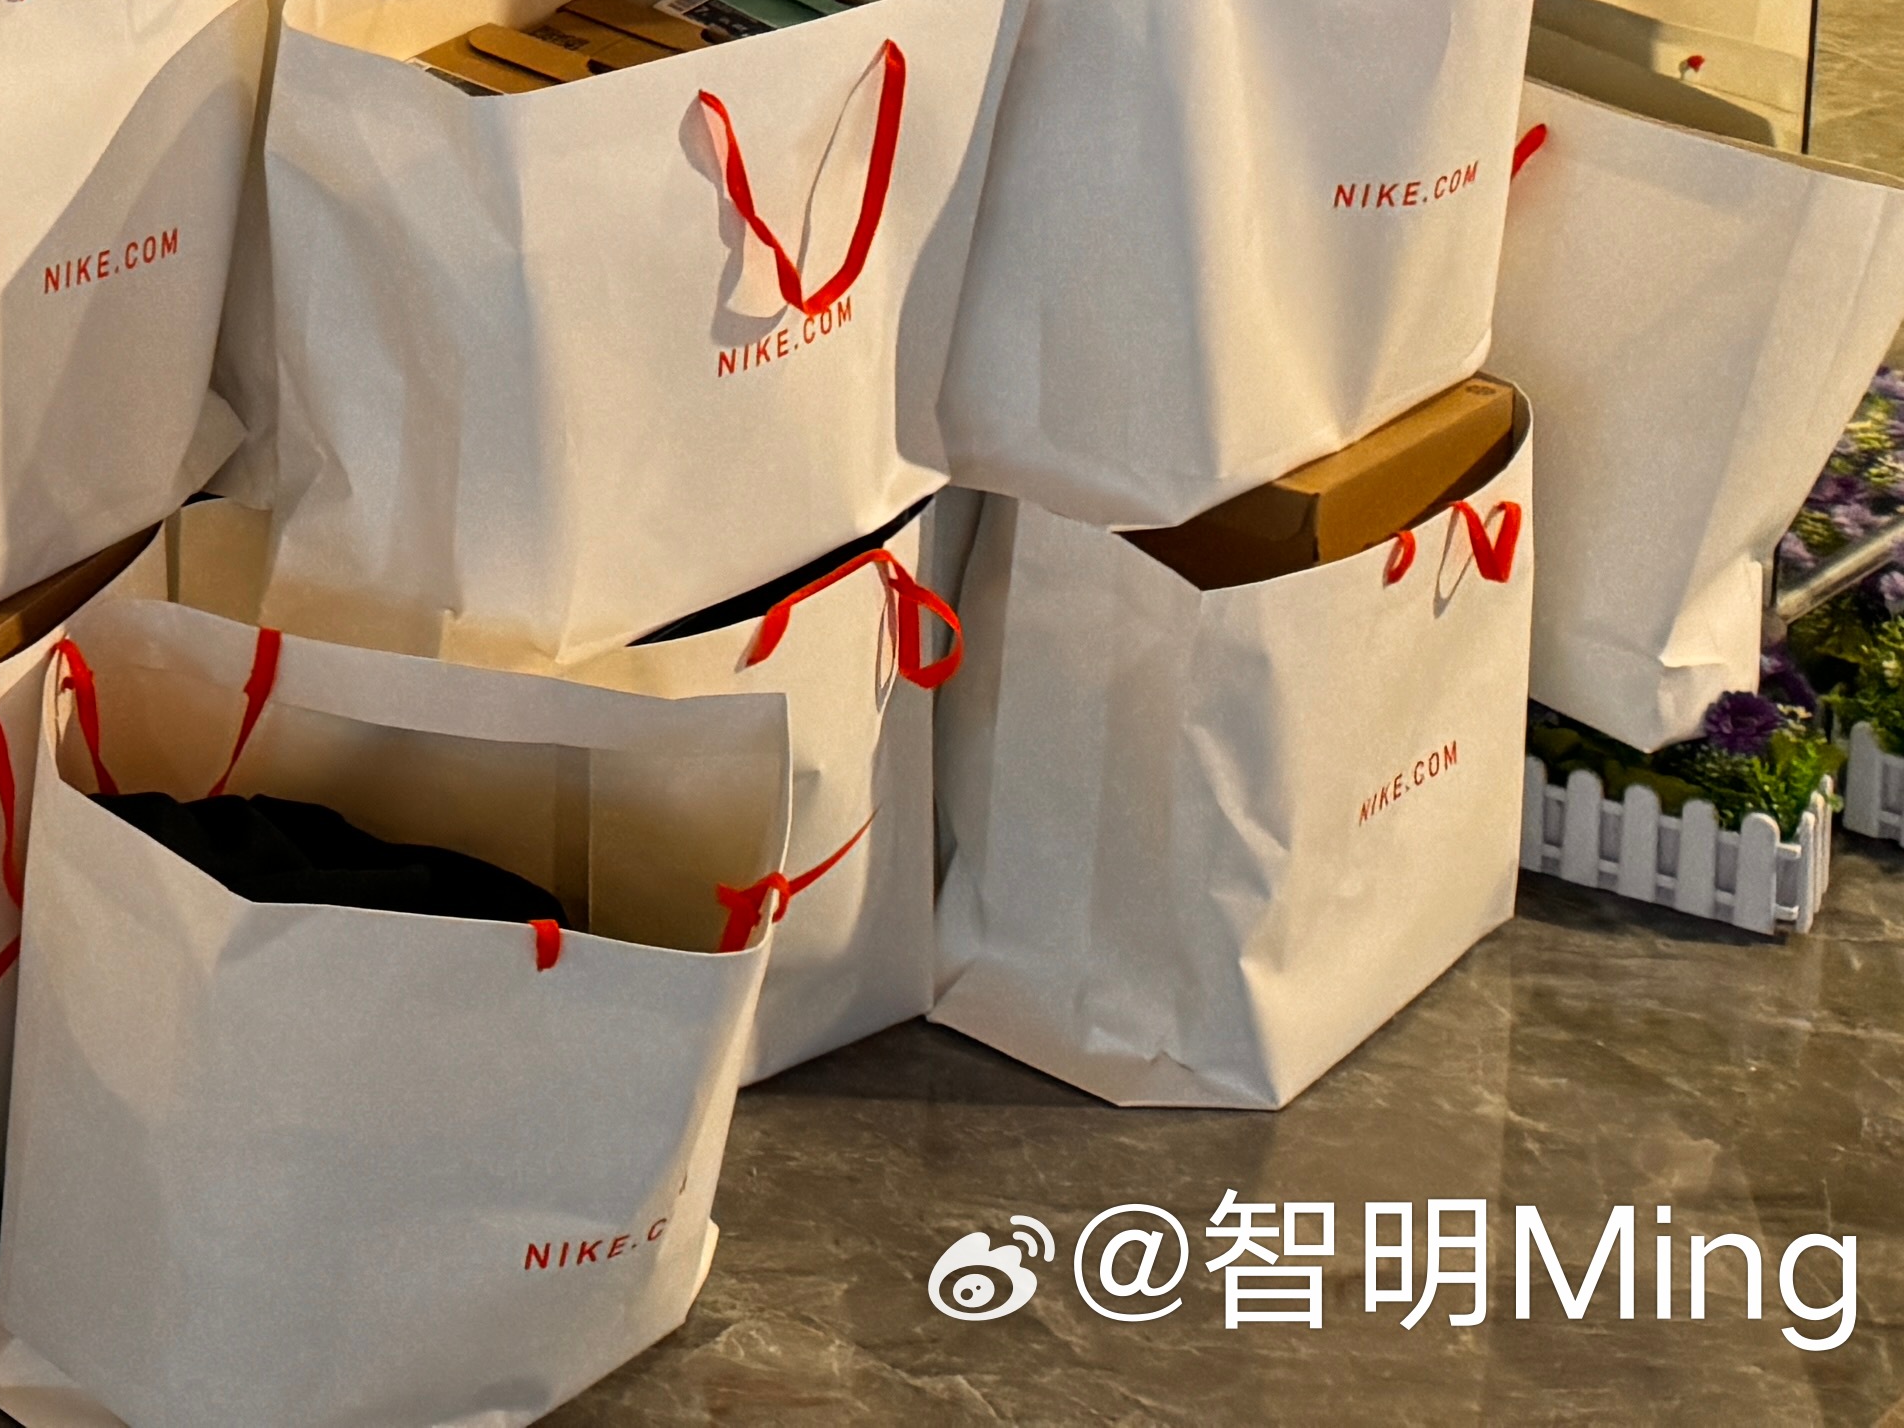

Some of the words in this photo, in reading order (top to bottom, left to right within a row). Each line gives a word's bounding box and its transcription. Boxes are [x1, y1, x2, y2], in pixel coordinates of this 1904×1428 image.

[1334, 159, 1481, 210] NIKE.COM
[43, 227, 182, 296] NIKE.COM
[716, 295, 854, 379] NIKE.COM
[1357, 739, 1459, 828] NIKE.COM
